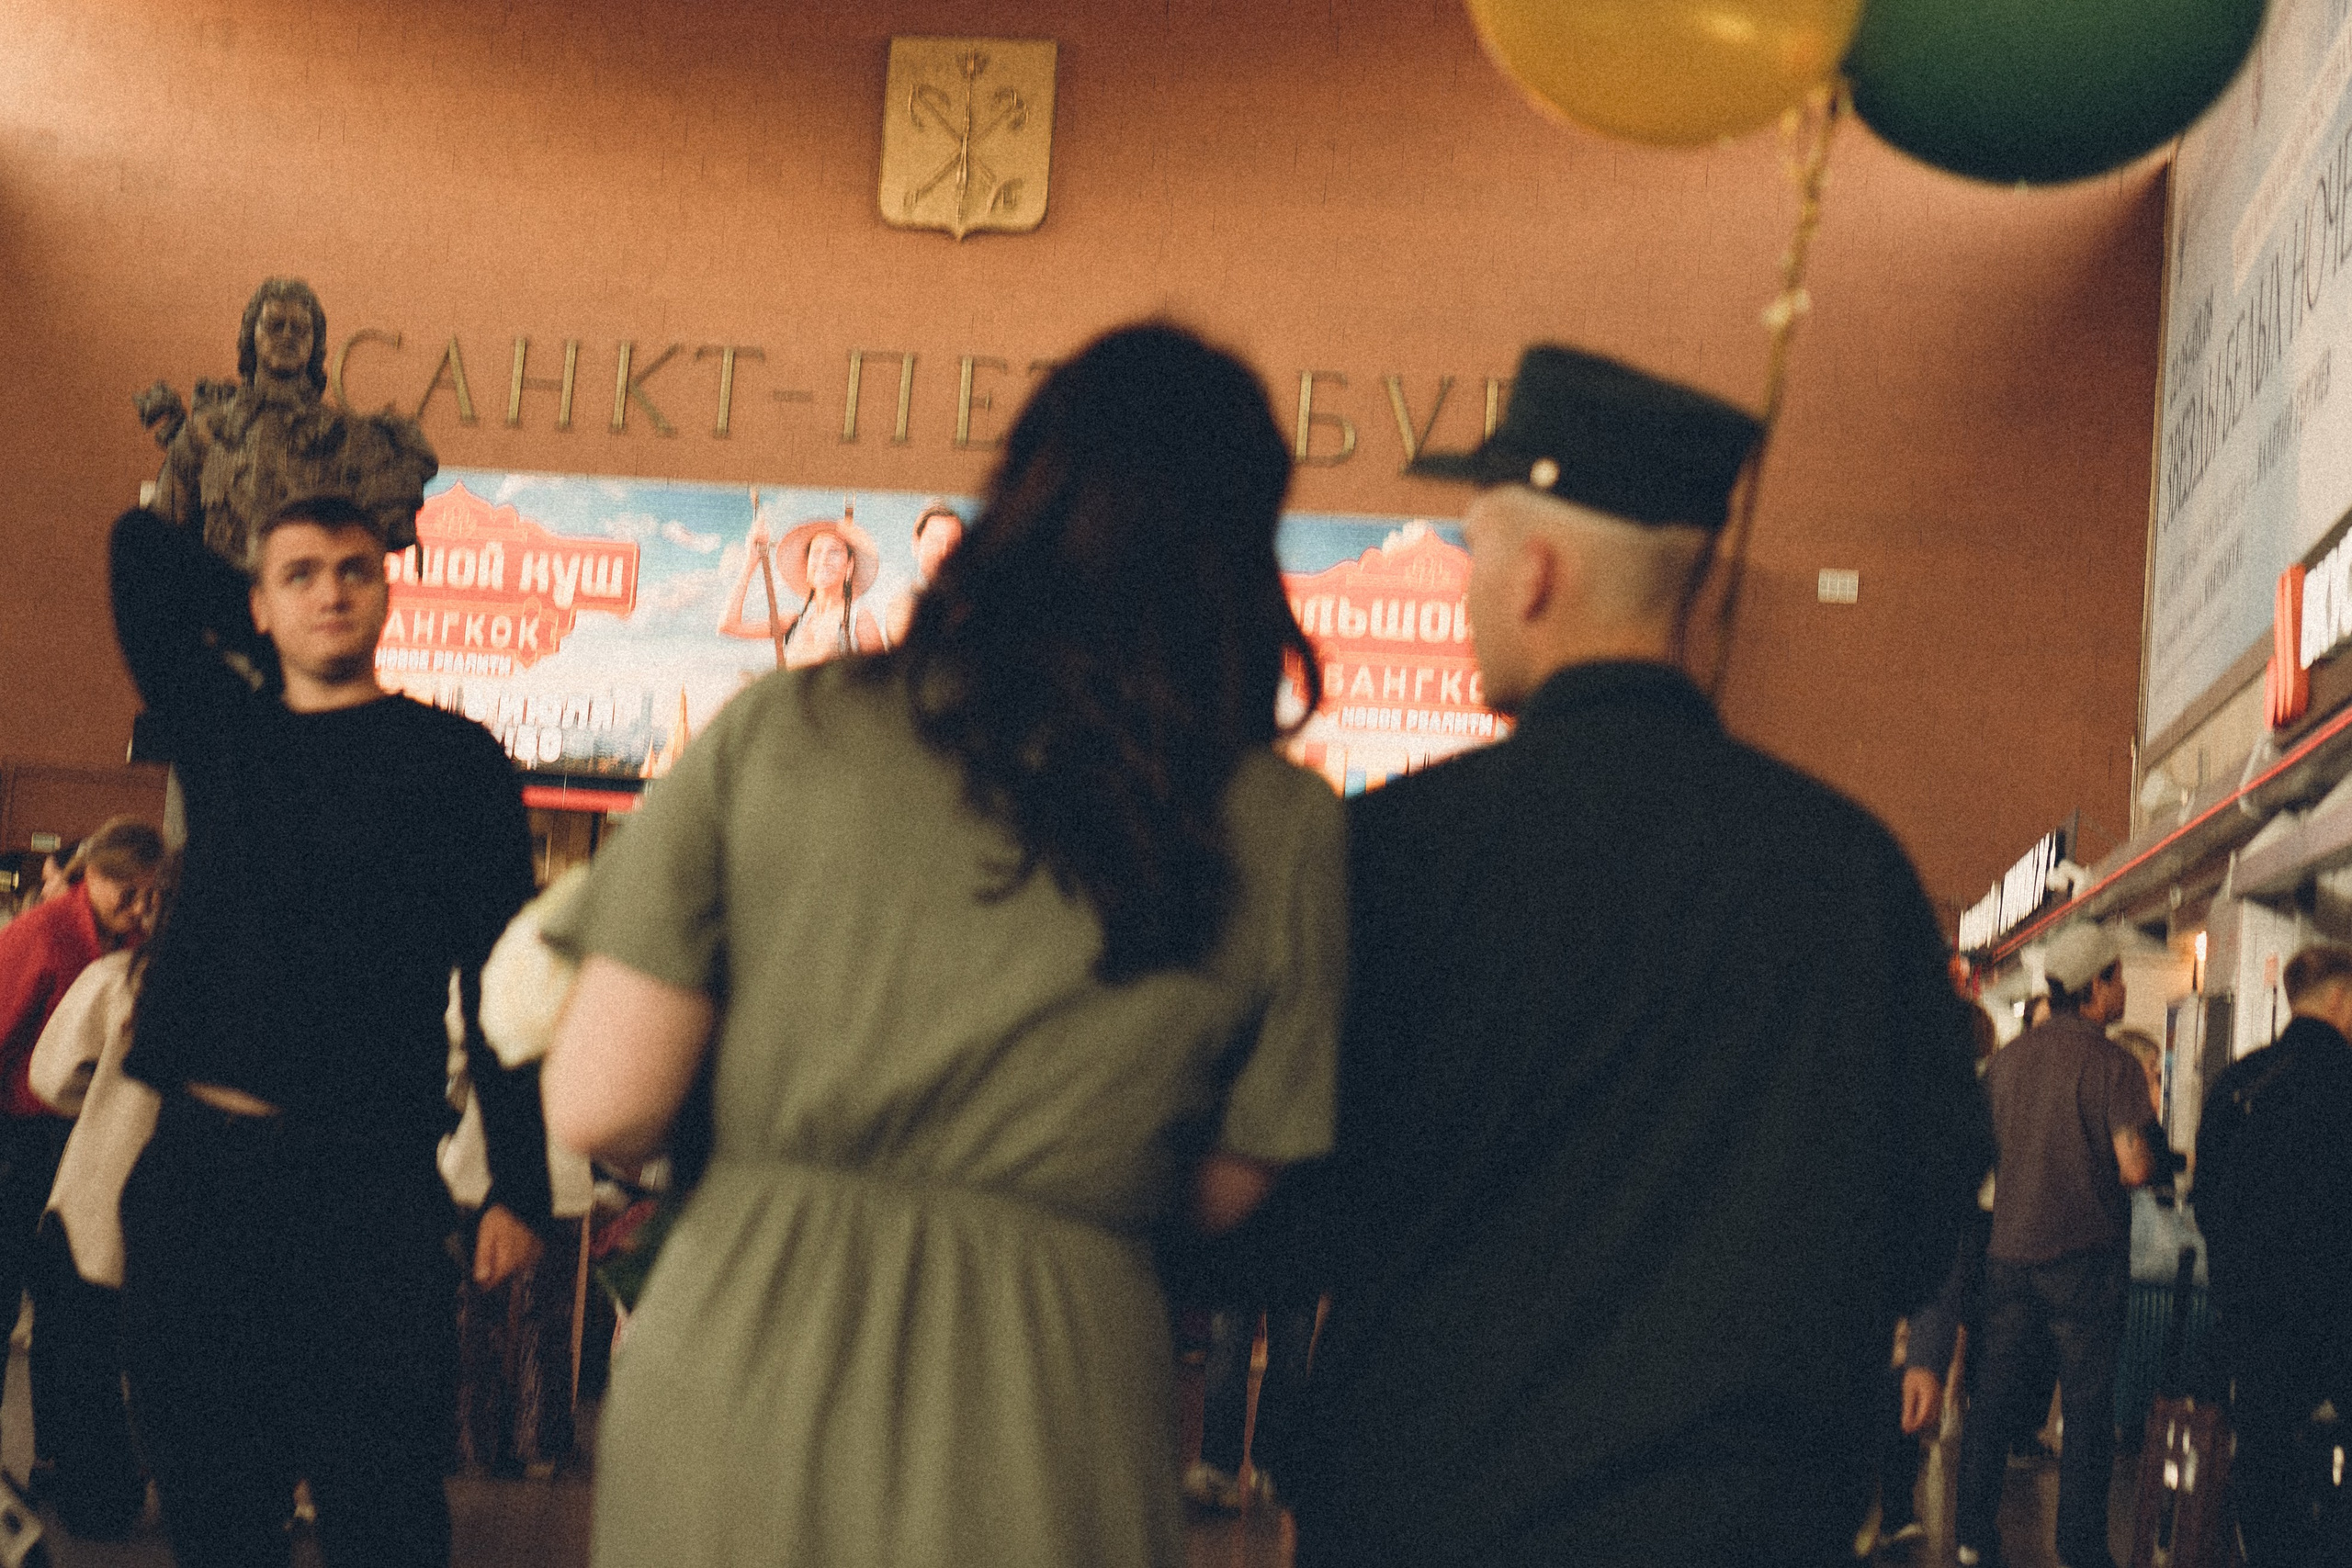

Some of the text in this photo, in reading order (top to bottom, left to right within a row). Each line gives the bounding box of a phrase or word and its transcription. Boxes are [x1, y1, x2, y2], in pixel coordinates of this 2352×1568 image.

[2162, 350, 2222, 535] ЗВЕЗДЫ
[2222, 236, 2287, 446] БЕЛЫХ
[383, 540, 626, 611] ЬШОЙ КУШ
[381, 608, 540, 650] АНГКОК
[1290, 593, 1472, 644] ЛЬШО
[1323, 663, 1484, 706] БАНГКО
